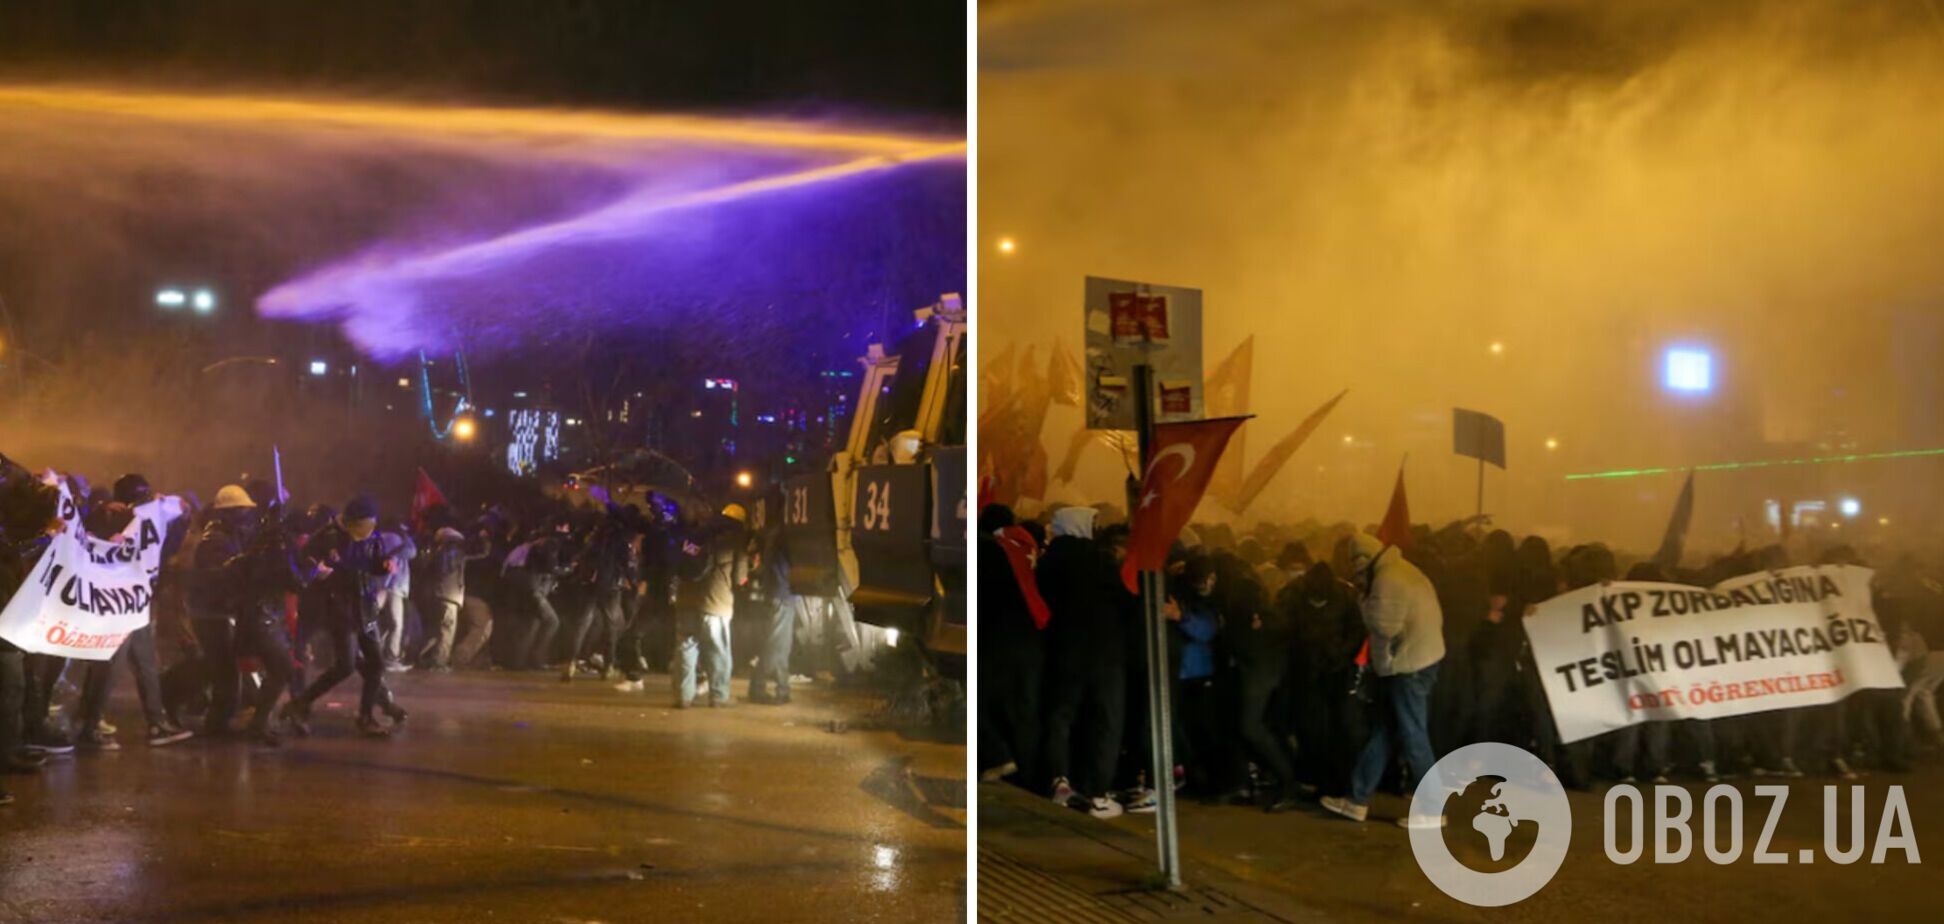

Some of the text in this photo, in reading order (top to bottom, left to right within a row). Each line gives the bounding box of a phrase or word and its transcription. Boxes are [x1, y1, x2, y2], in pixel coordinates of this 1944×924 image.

[792, 486, 808, 525] 31
[863, 481, 890, 530] 34
[1581, 591, 1642, 633] AKP
[1556, 612, 1876, 693] TESLİM OLMAYACAĞIZ
